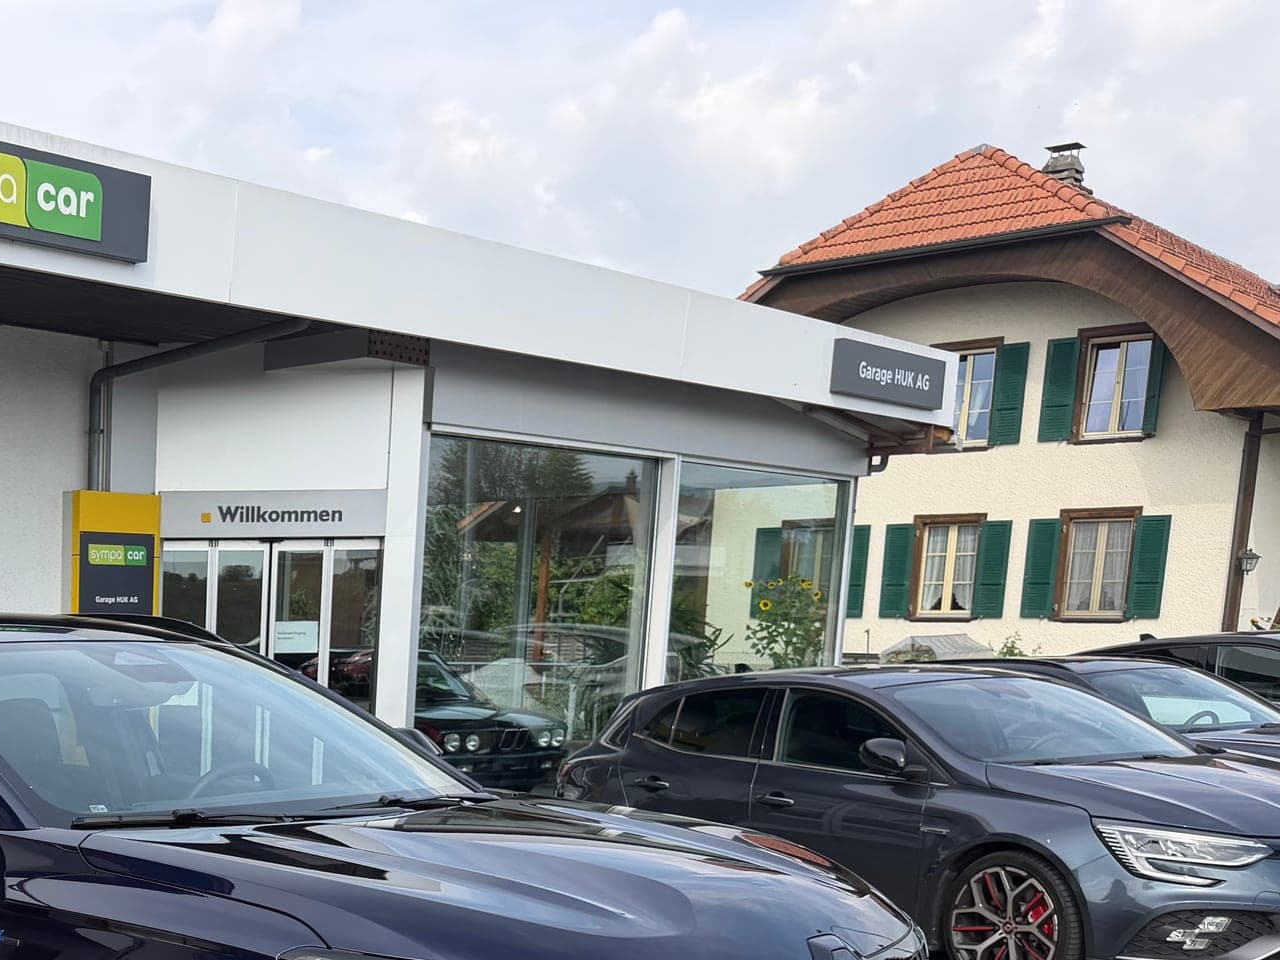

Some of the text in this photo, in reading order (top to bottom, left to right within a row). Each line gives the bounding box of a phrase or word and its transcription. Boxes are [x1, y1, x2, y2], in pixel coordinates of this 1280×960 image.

[36, 182, 95, 218] car
[858, 361, 930, 391] Garage HUK AG
[217, 505, 343, 523] Willkommen
[90, 550, 145, 562] sympa car
[95, 596, 116, 605] Garage
